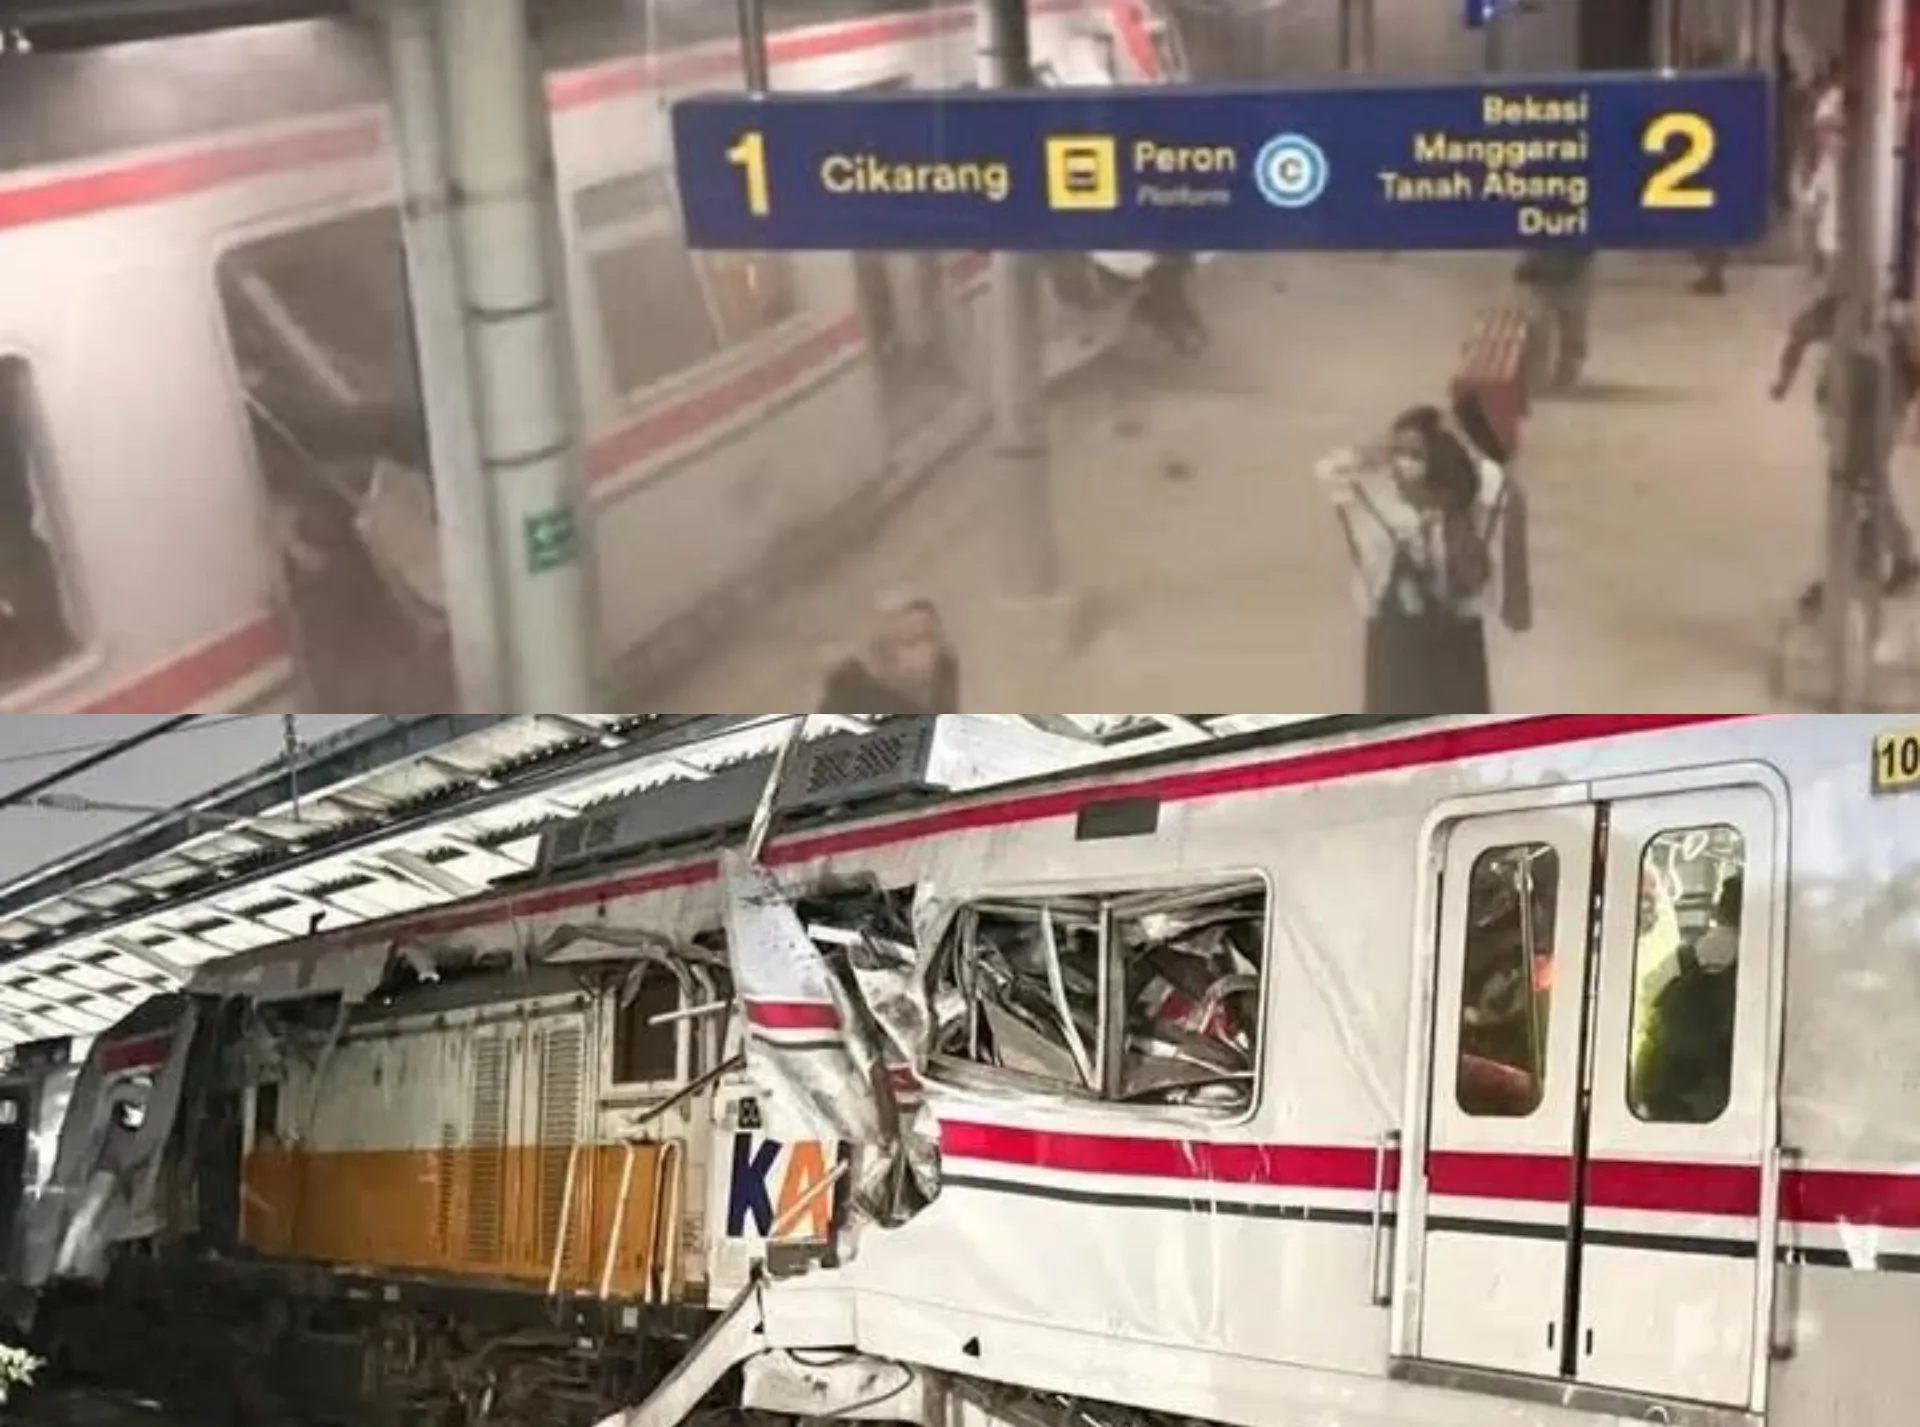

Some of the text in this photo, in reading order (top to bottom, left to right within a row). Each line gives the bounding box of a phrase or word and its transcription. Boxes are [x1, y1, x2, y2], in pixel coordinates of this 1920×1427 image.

[1483, 94, 1588, 125] Bekasi
[1133, 141, 1236, 173] Peron
[1413, 131, 1588, 170] Manggarai
[1640, 113, 1716, 208] 2
[726, 133, 769, 215] 1
[820, 156, 1010, 201] Cikarang
[1279, 157, 1303, 185] C
[1379, 171, 1588, 204] Tanah Abang
[1518, 205, 1588, 236] Duri
